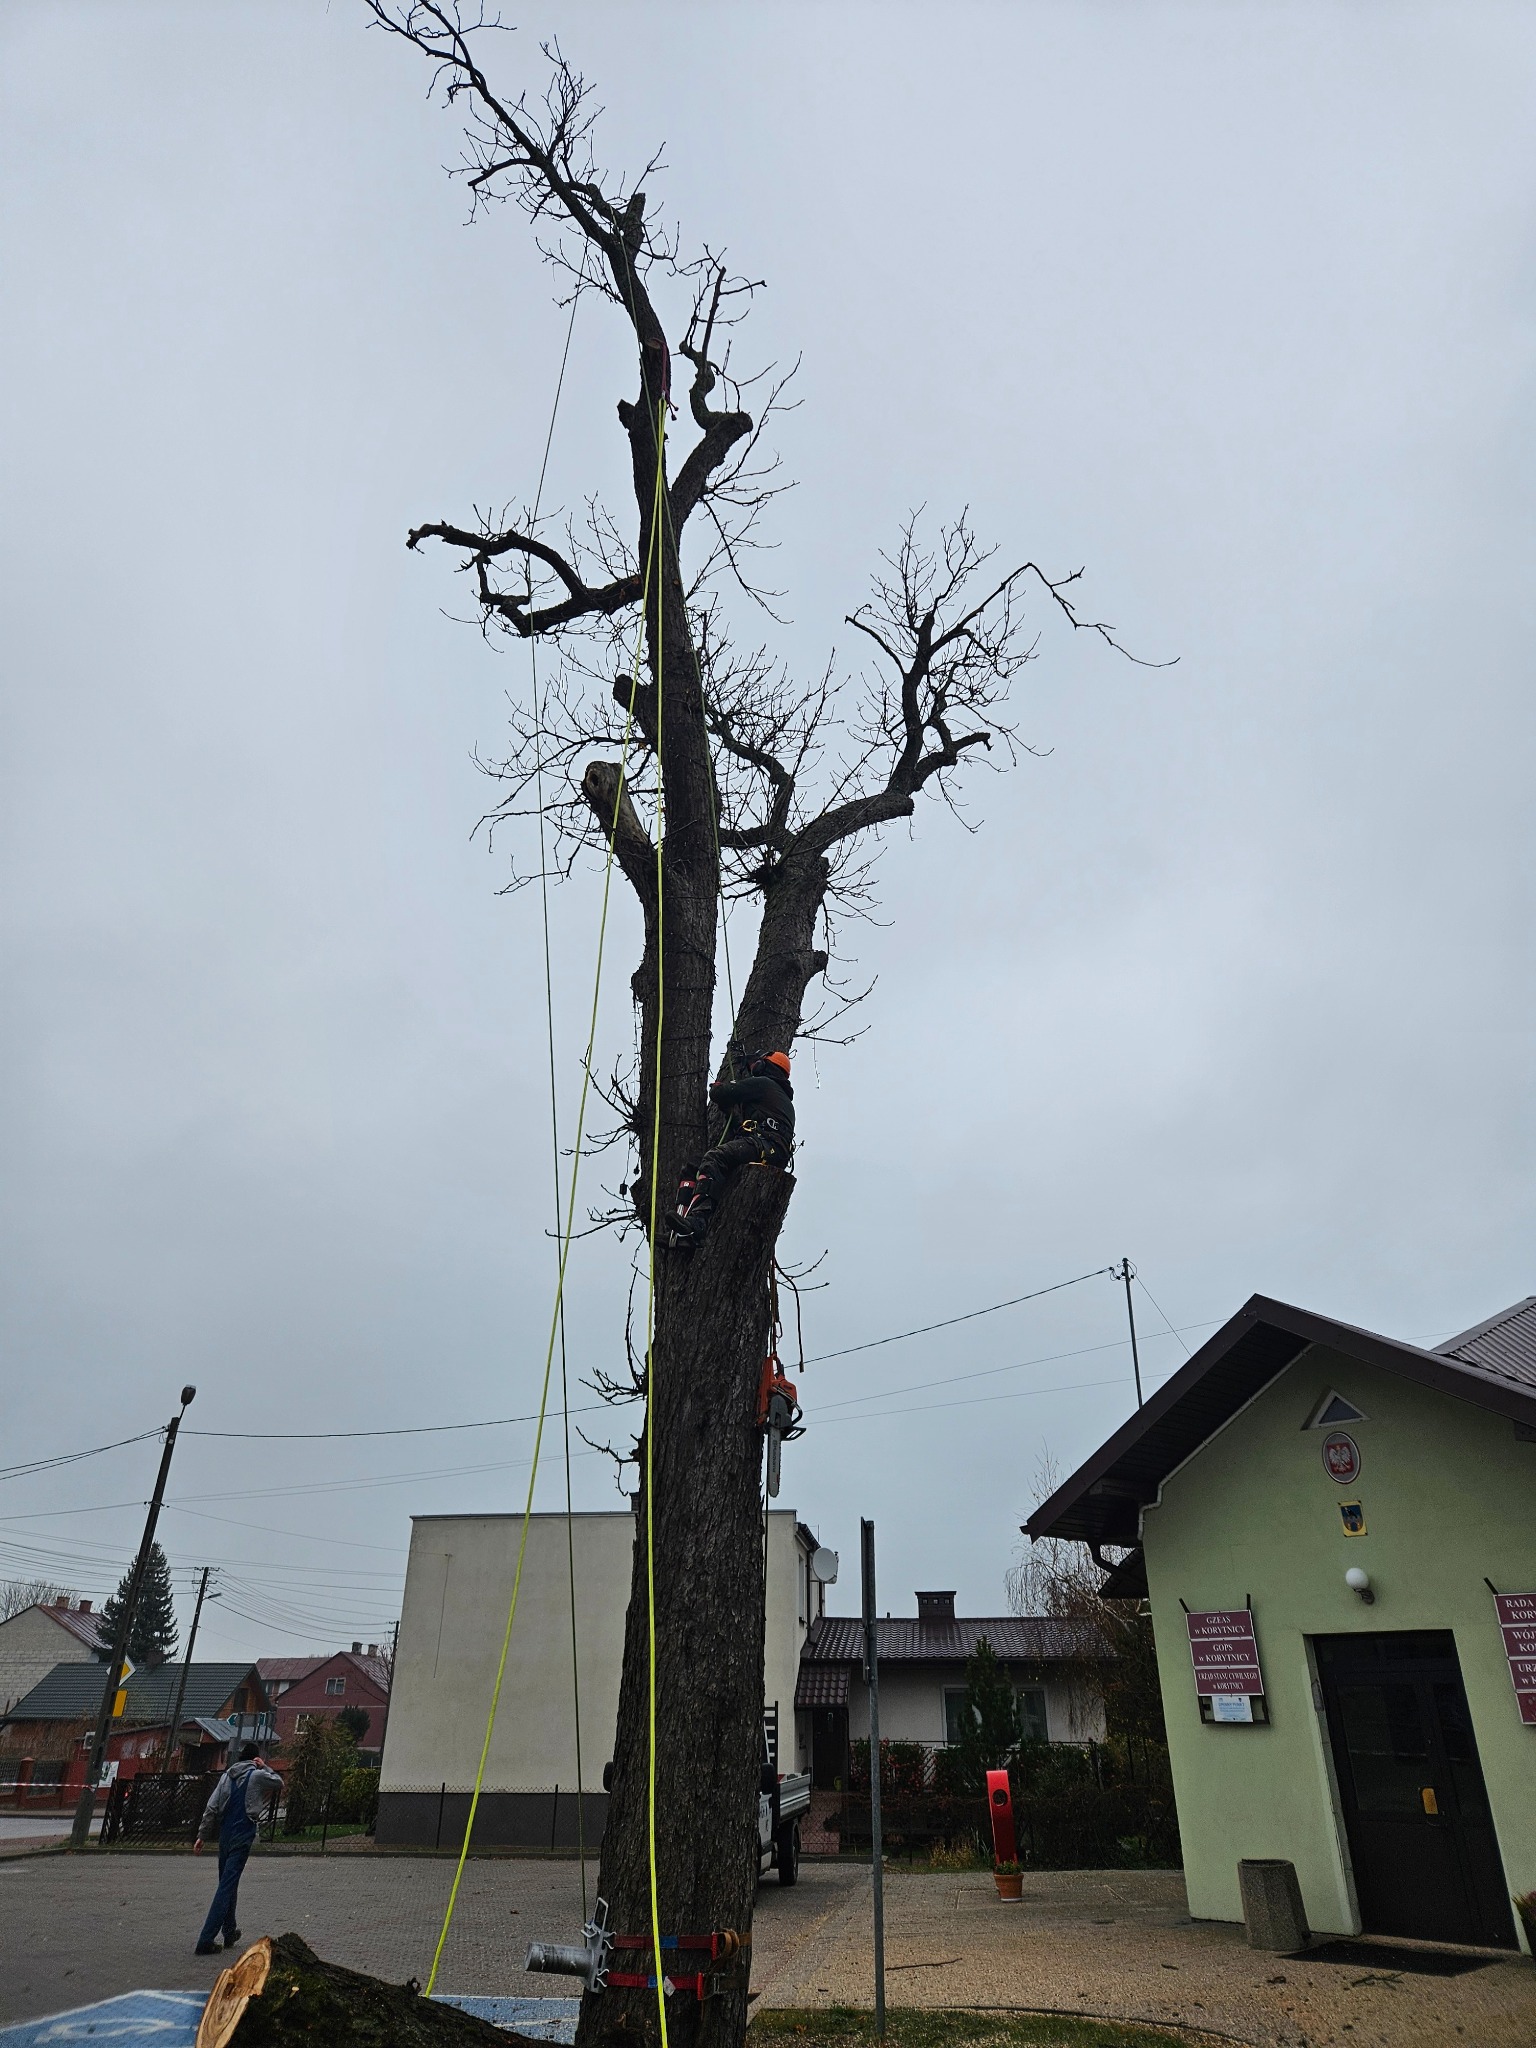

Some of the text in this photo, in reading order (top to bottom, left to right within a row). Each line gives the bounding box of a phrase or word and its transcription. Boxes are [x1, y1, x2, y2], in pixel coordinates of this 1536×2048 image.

[1505, 1599, 1534, 1608] RADA
[1206, 1616, 1231, 1624] GZEAS
[1201, 1625, 1246, 1635] KORYTNICY
[1512, 1629, 1536, 1640] WÓJ
[1212, 1643, 1233, 1652] GOPS
[1519, 1643, 1536, 1652] KO
[1205, 1653, 1250, 1662] KORYTNICY
[1229, 1672, 1257, 1680] CYWILNEGO
